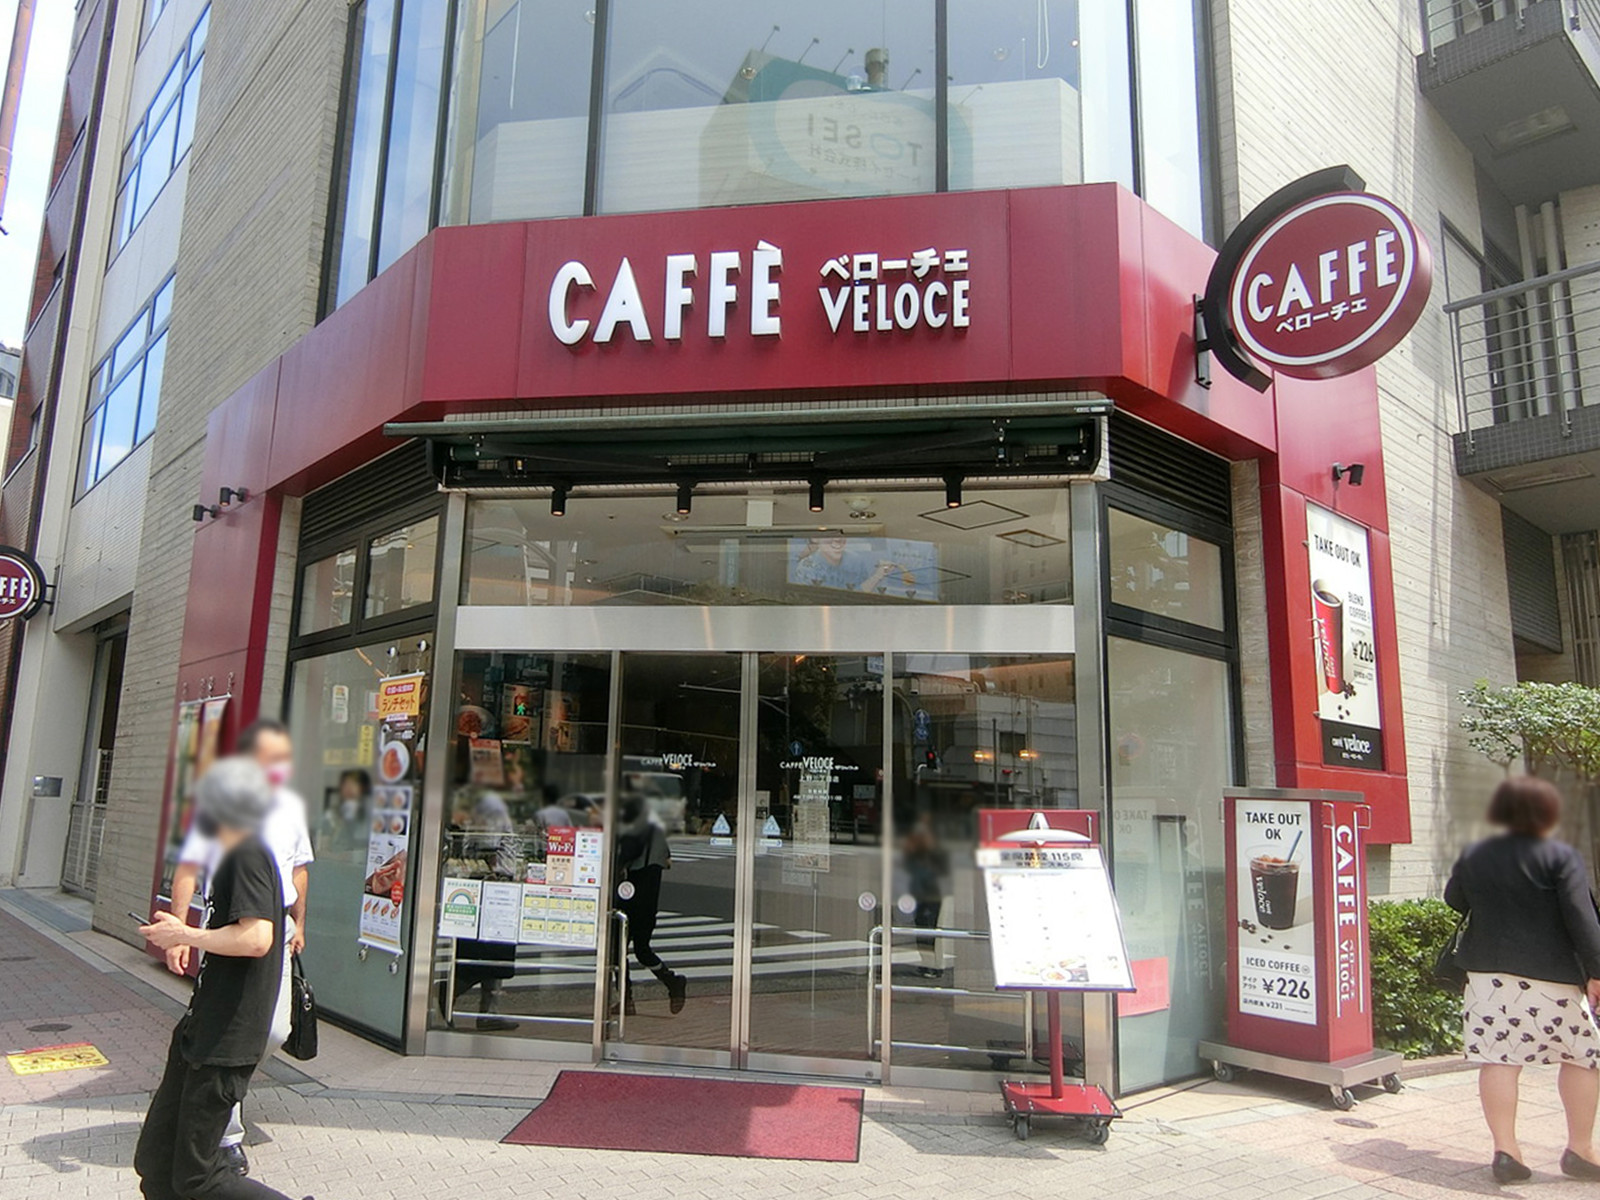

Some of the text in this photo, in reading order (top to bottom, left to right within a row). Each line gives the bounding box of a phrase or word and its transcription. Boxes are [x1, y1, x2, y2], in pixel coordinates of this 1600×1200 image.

[1247, 229, 1398, 323] CAFFÈ
[548, 240, 970, 346] CAFFÈ VELOCE
[1313, 534, 1362, 568] TAKE OUT OK
[382, 694, 416, 712] ランチセット
[1343, 733, 1372, 753] veloce
[662, 753, 694, 767] VELOCE
[802, 756, 835, 770] VELOCE
[1245, 812, 1301, 825] TAKE OUT
[1265, 828, 1282, 840] OK
[548, 841, 574, 853] Wi-Fi
[1256, 876, 1267, 913] veloce
[1246, 957, 1300, 973] ICED COFFEE
[1339, 939, 1350, 1002] VELOCE
[1262, 977, 1310, 1000] ¥226
